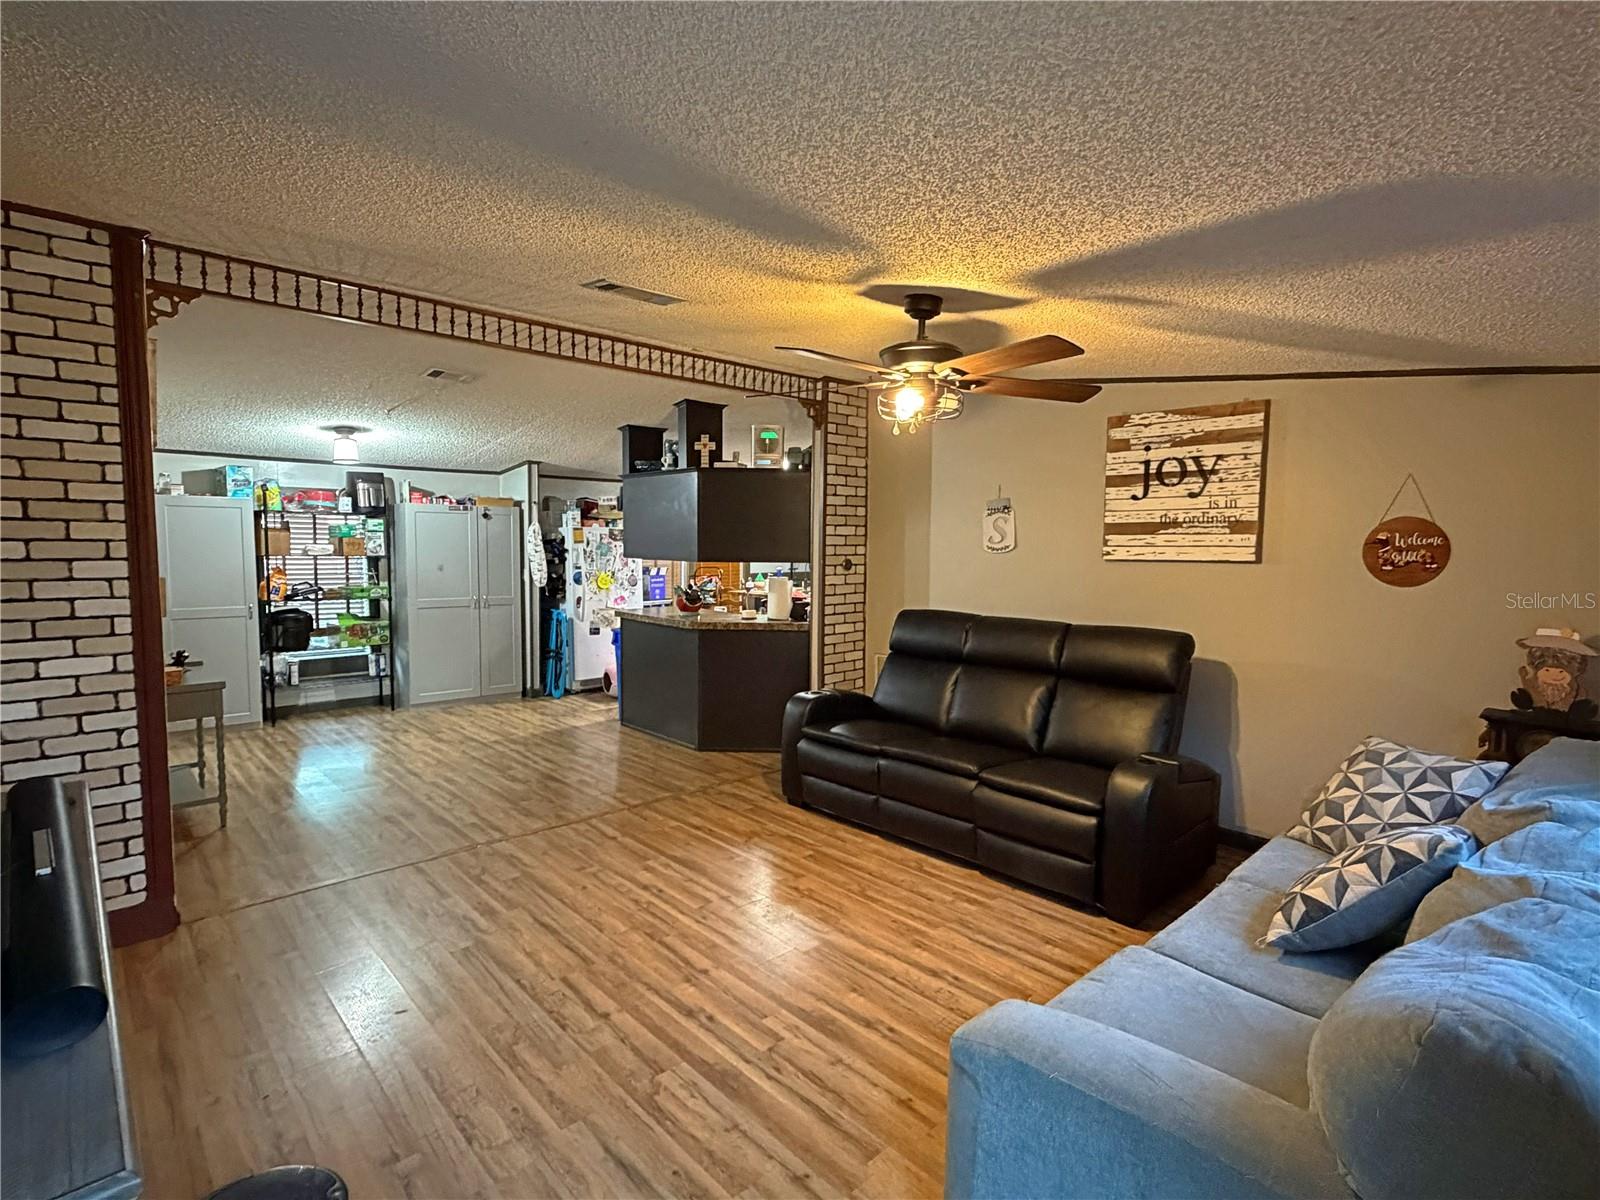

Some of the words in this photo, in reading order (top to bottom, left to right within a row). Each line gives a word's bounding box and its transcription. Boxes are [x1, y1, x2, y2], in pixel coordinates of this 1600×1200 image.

[1130, 445, 1223, 501] joy
[1208, 497, 1219, 509] is
[1225, 497, 1238, 509] in
[1160, 512, 1179, 525] the
[988, 516, 1009, 544] S
[1395, 532, 1445, 548] Welcome
